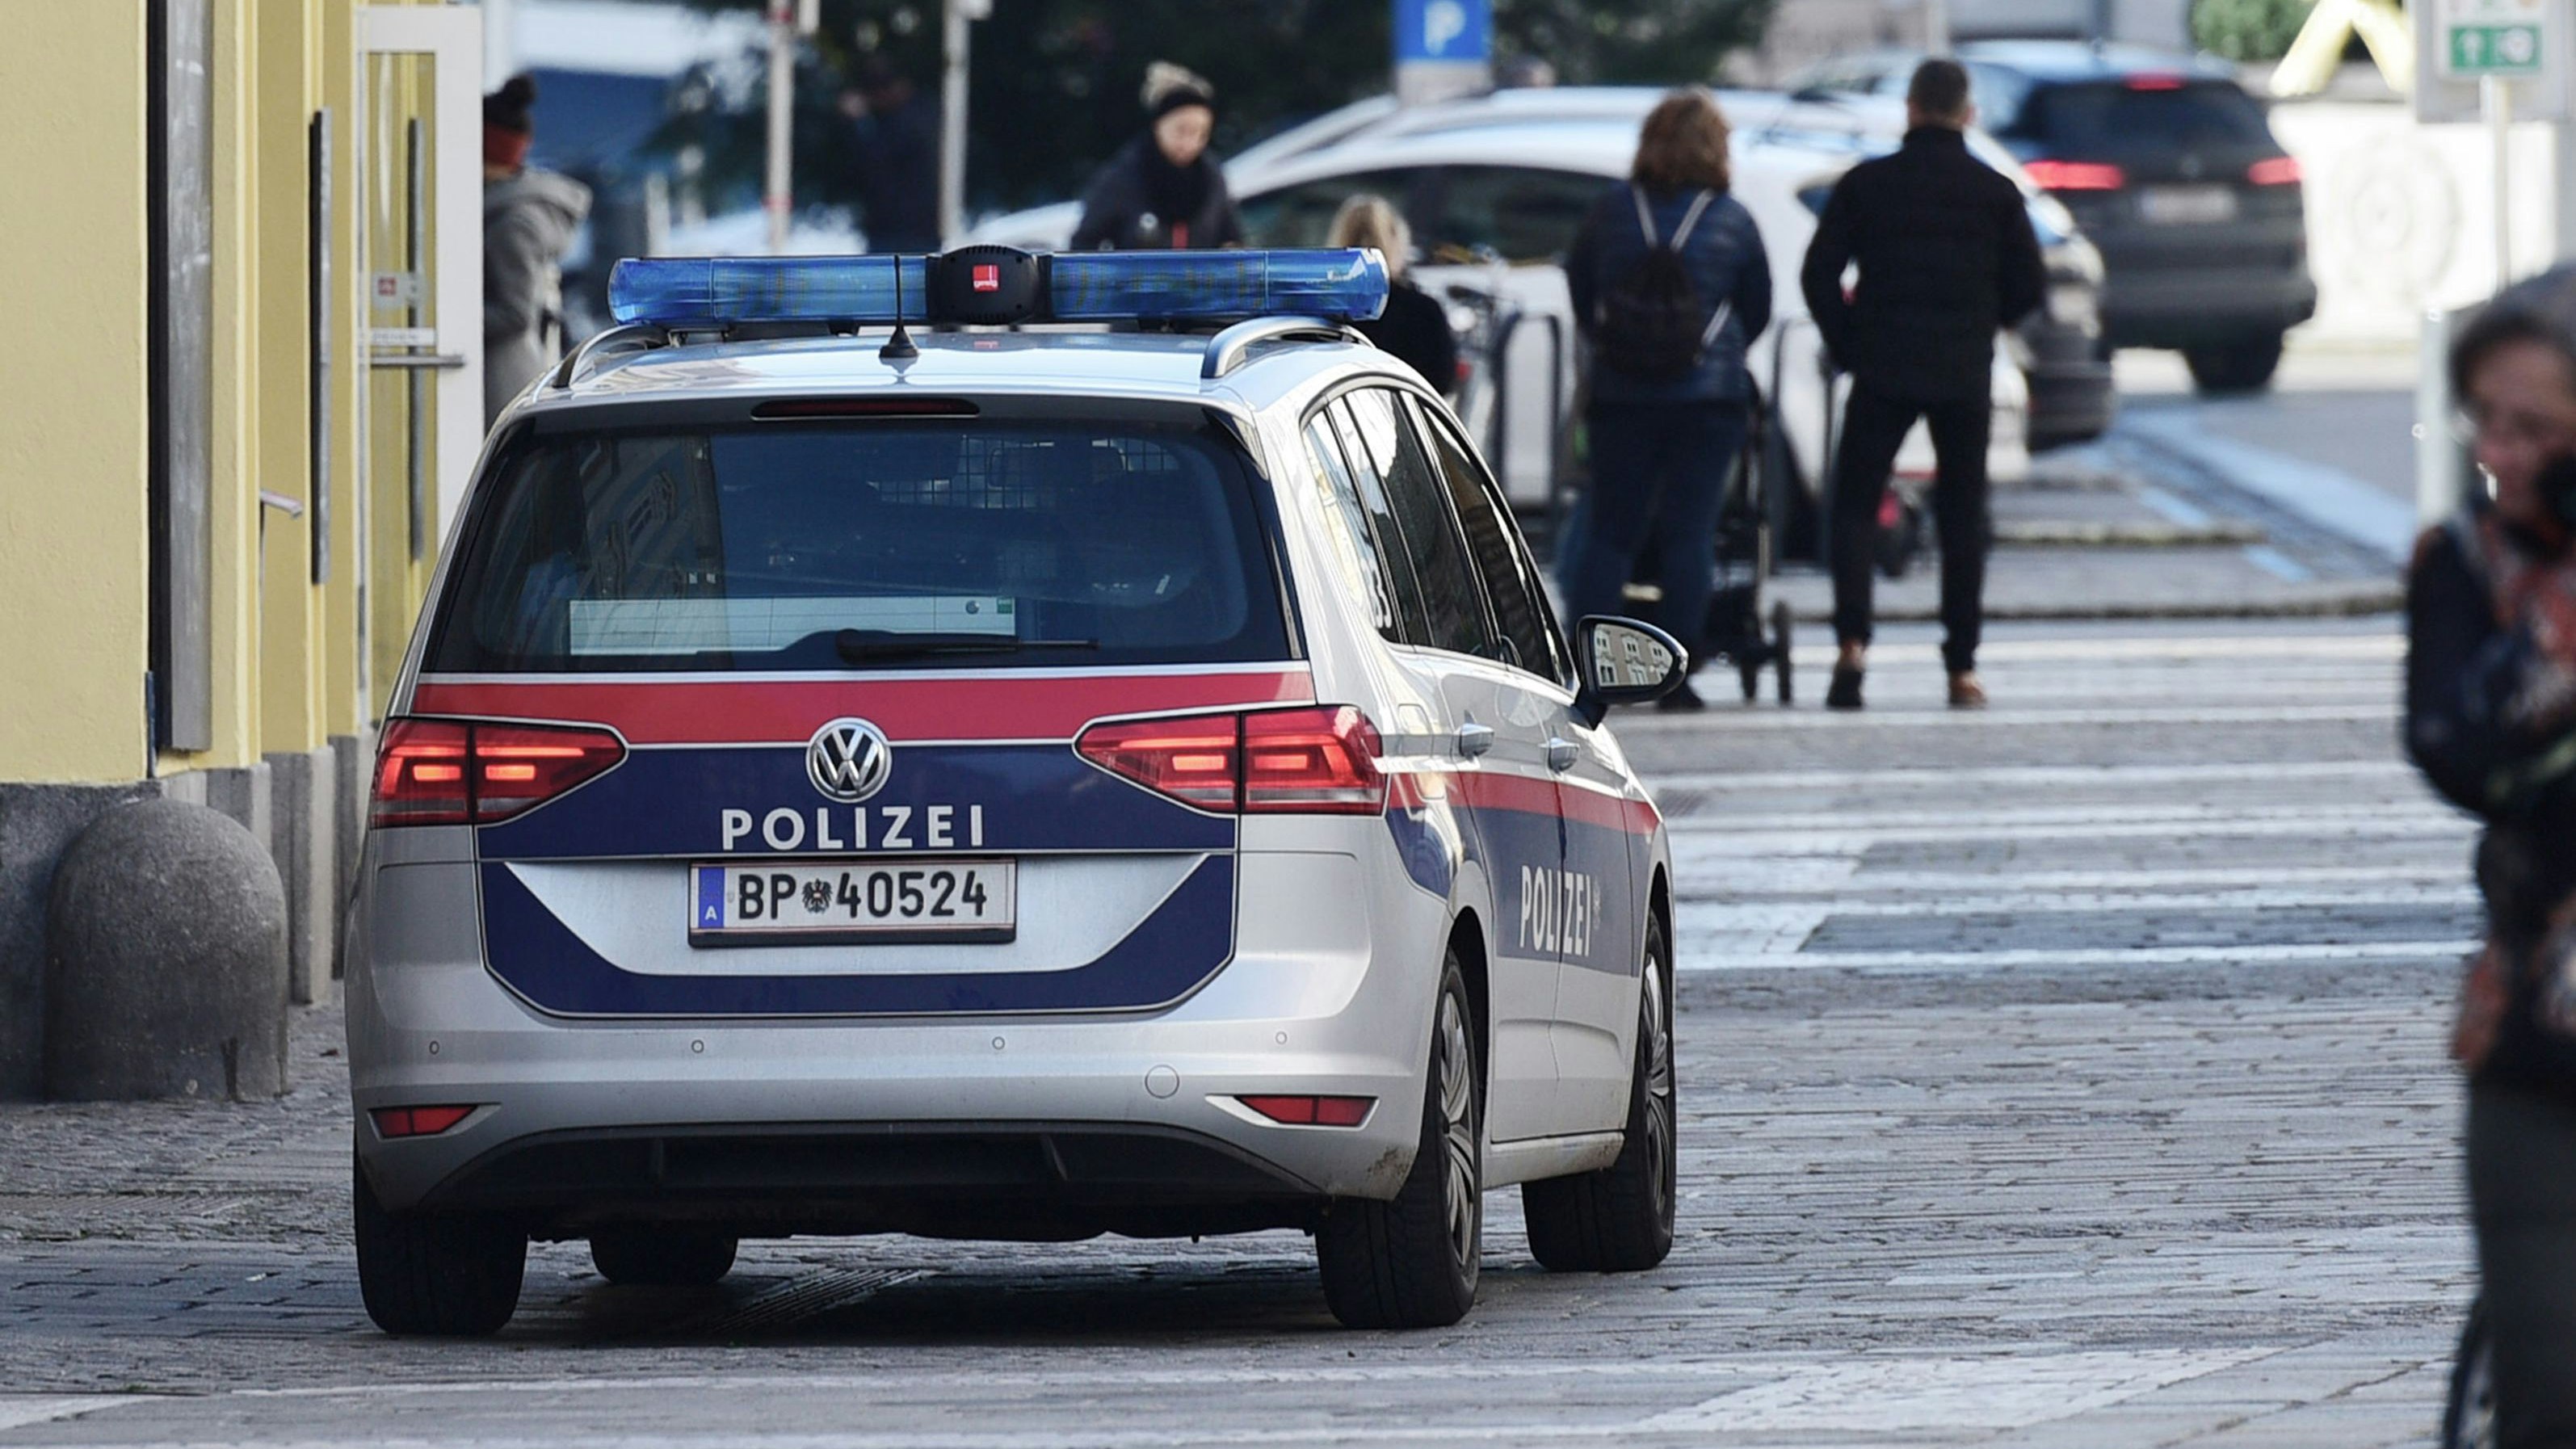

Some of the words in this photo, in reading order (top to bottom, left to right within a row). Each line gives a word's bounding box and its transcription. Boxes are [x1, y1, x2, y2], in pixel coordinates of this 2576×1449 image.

[1423, 1, 1467, 55] P
[721, 804, 983, 850] POLIZEI
[704, 905, 718, 921] A
[738, 873, 796, 920] BP
[836, 870, 987, 918] 40524
[1519, 865, 1591, 957] POLIZEI
